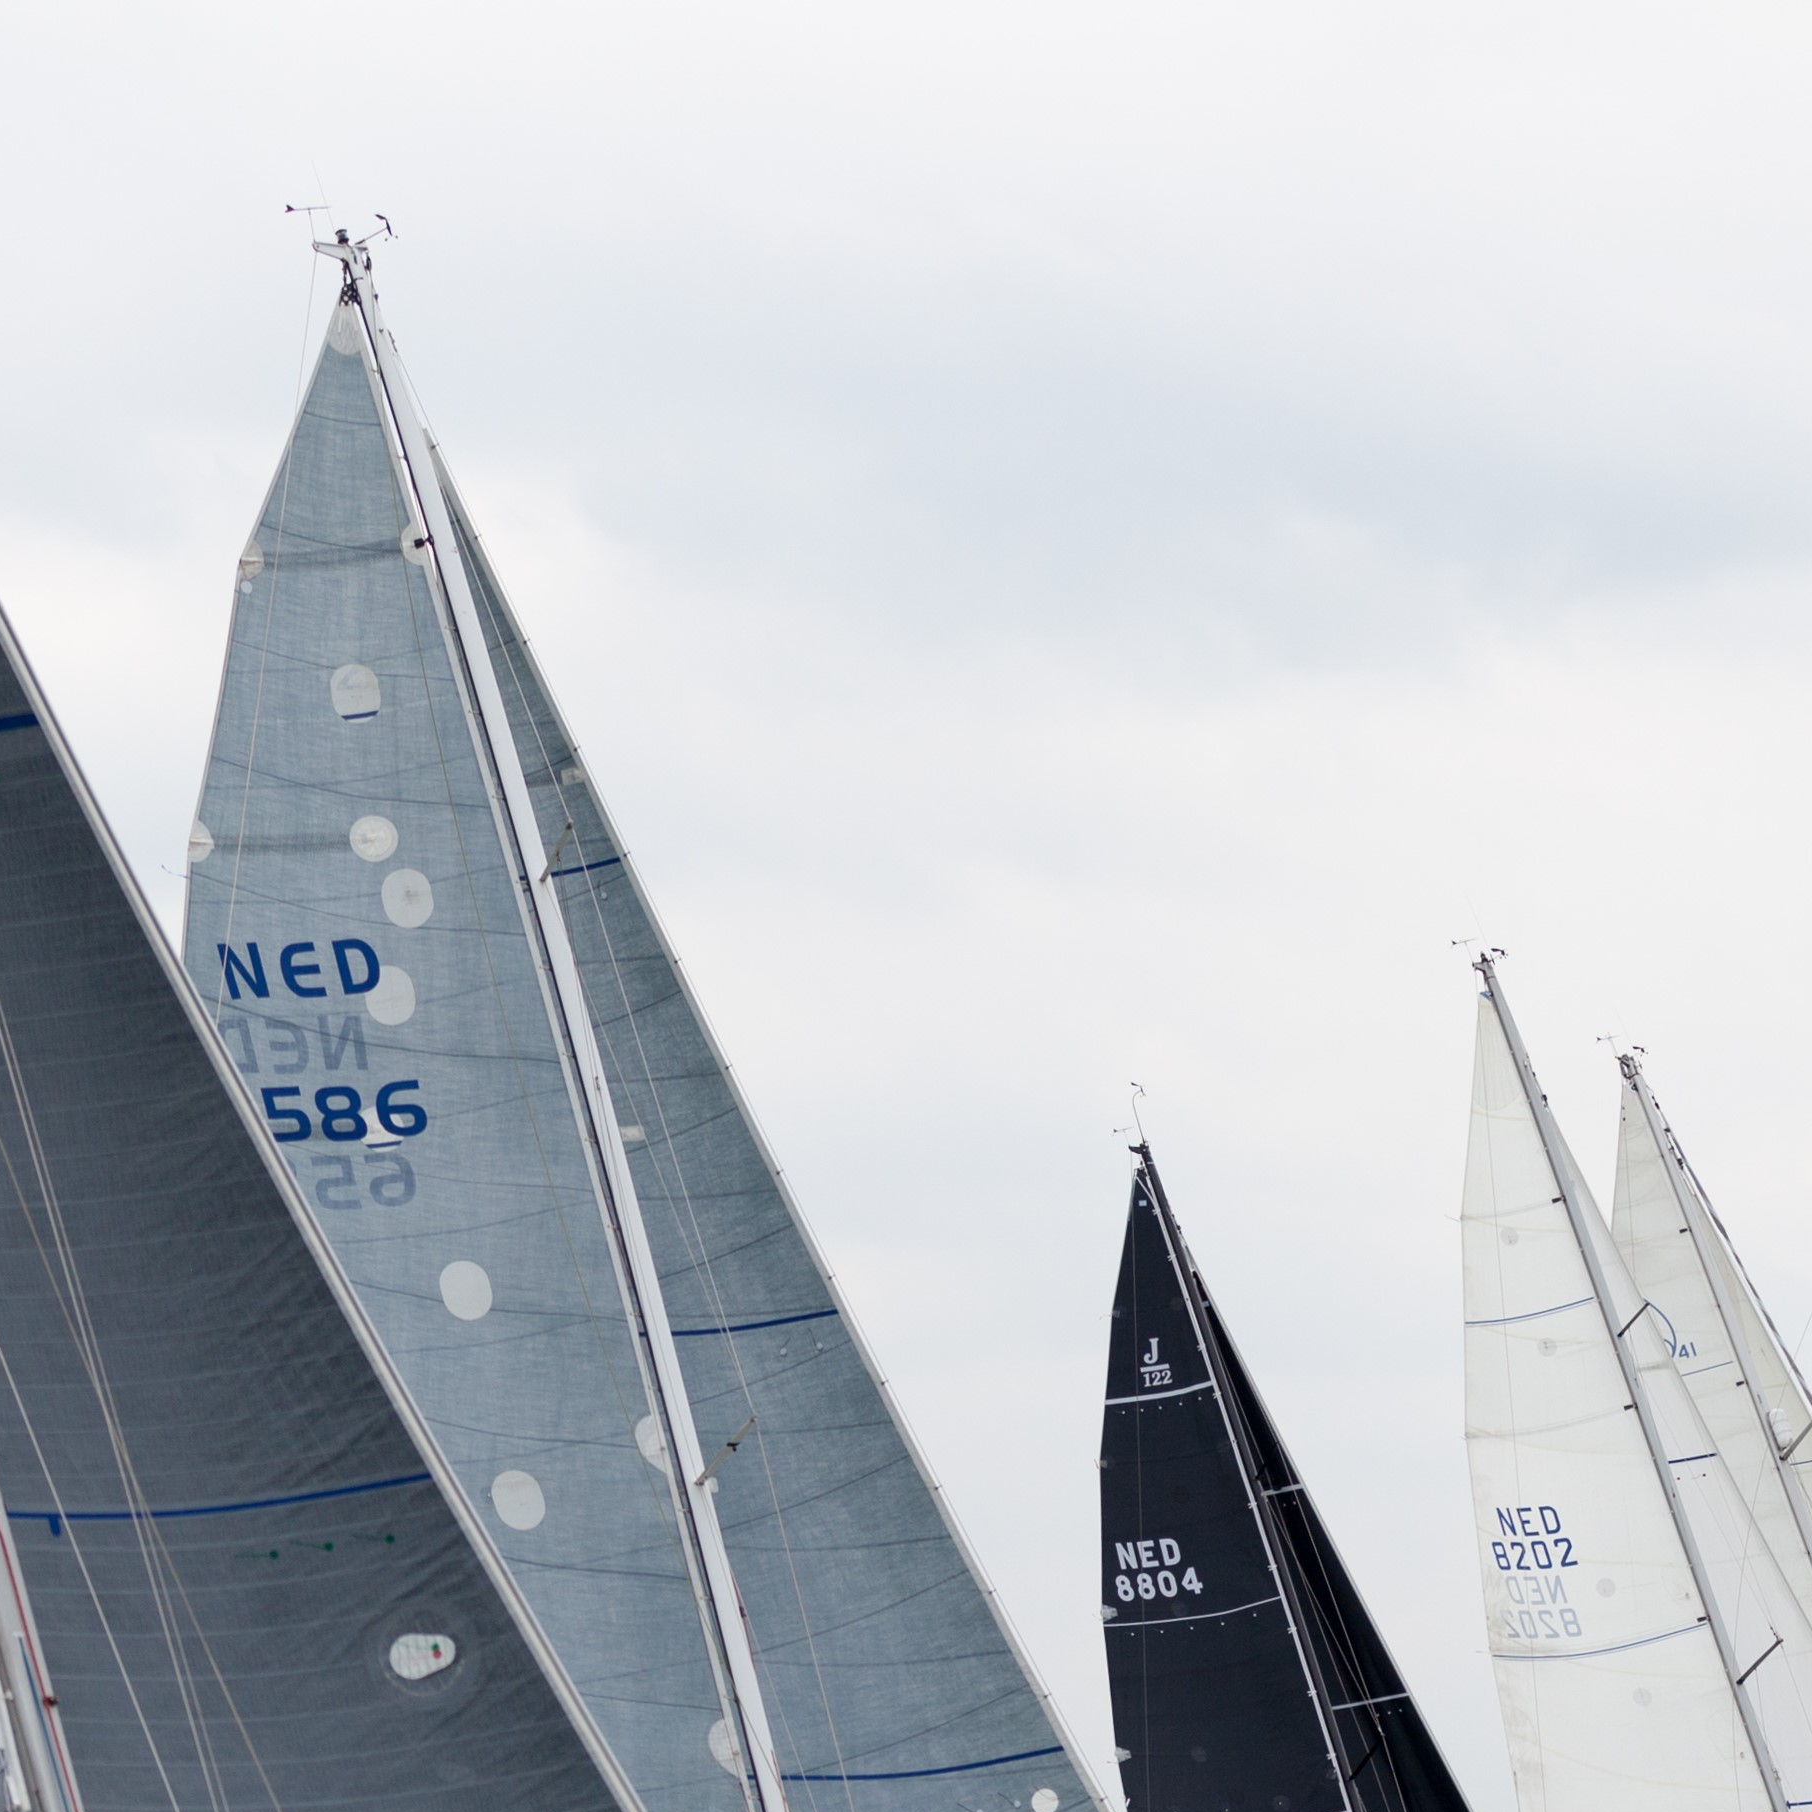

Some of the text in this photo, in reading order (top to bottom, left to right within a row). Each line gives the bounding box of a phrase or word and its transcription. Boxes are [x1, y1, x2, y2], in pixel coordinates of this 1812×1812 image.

[216, 938, 380, 1000] NED
[260, 1079, 428, 1142] 586
[1143, 1337, 1160, 1365] J
[1143, 1369, 1173, 1388] 122
[1496, 1505, 1561, 1537] NED
[1114, 1537, 1182, 1571] NED
[1491, 1537, 1579, 1571] 8202
[1114, 1566, 1204, 1602] 8804
